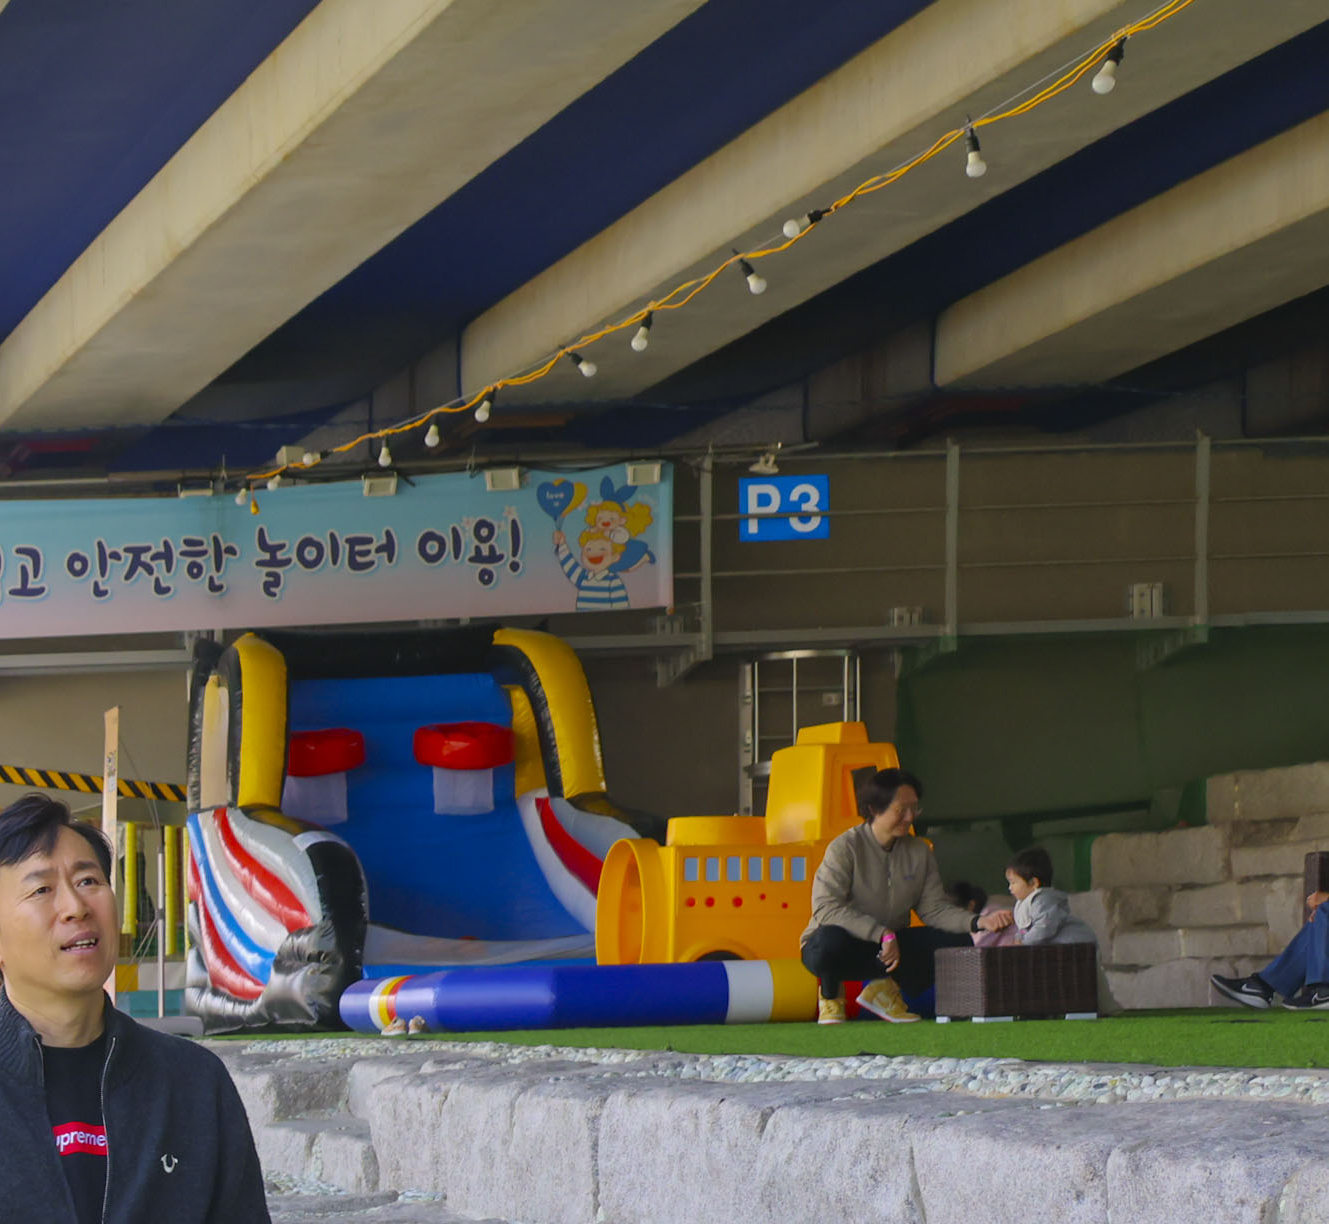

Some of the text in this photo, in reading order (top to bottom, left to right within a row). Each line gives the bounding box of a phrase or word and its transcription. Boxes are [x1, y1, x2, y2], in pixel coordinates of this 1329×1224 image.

[748, 483, 821, 534] P3
[66, 533, 238, 598] 안전한
[255, 526, 396, 598] 놀이터
[417, 517, 522, 586] 이용!
